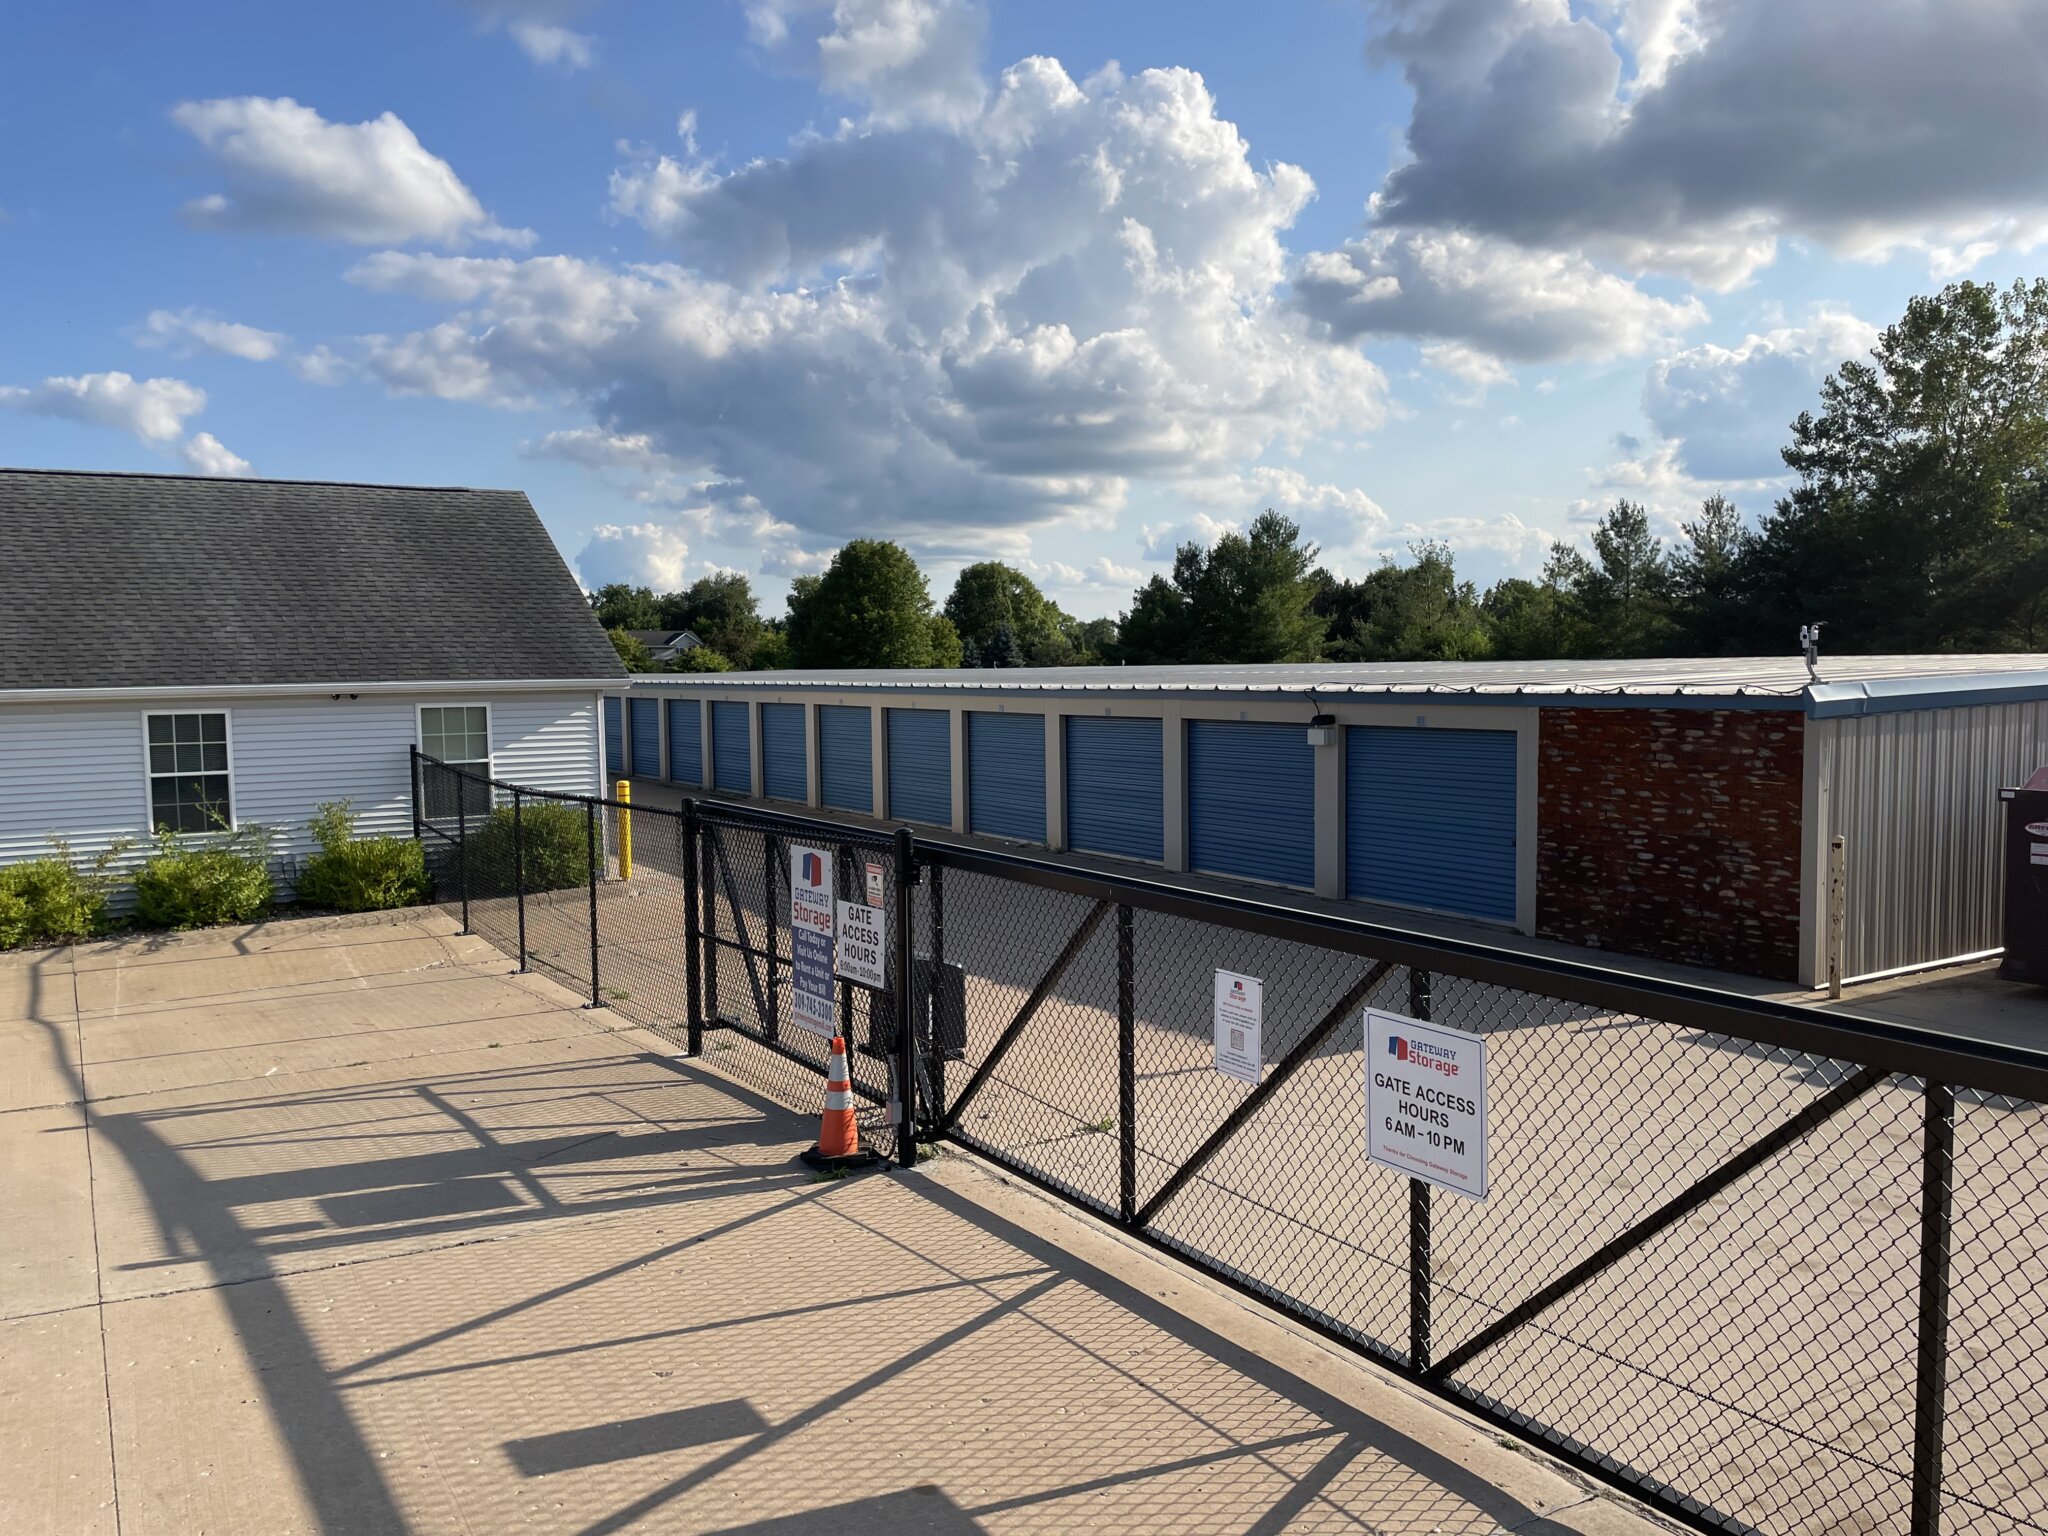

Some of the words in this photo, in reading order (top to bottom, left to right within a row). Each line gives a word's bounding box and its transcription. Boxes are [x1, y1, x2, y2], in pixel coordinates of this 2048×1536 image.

[794, 887, 829, 908] GATEWAY
[793, 901, 831, 932] Storage
[848, 906, 872, 925] GATE
[798, 929, 807, 942] Call
[807, 931, 820, 948] Today
[820, 938, 826, 948] or
[842, 923, 879, 946] ACCESS
[796, 943, 807, 957] Visit
[807, 947, 813, 959] Us
[813, 949, 828, 965] Online
[844, 942, 877, 965] HOURS
[795, 960, 801, 971] to
[801, 961, 811, 975] Rent
[815, 965, 825, 979] Unit
[800, 976, 808, 991] Pay
[808, 979, 818, 993] Your
[818, 983, 826, 996] Bill
[794, 991, 832, 1022] 309-745-3300
[1410, 1040, 1457, 1061] GATEWAY
[1409, 1050, 1460, 1077] Storage
[1374, 1073, 1411, 1096] GATE
[1415, 1085, 1476, 1116] ACCESS
[1398, 1099, 1449, 1128] HOURS
[1443, 1135, 1465, 1156] PM
[1383, 1144, 1399, 1156] Thanks
[1406, 1153, 1429, 1168] Choosing
[1428, 1161, 1449, 1175] Gateway
[1449, 1168, 1469, 1181] Storage
